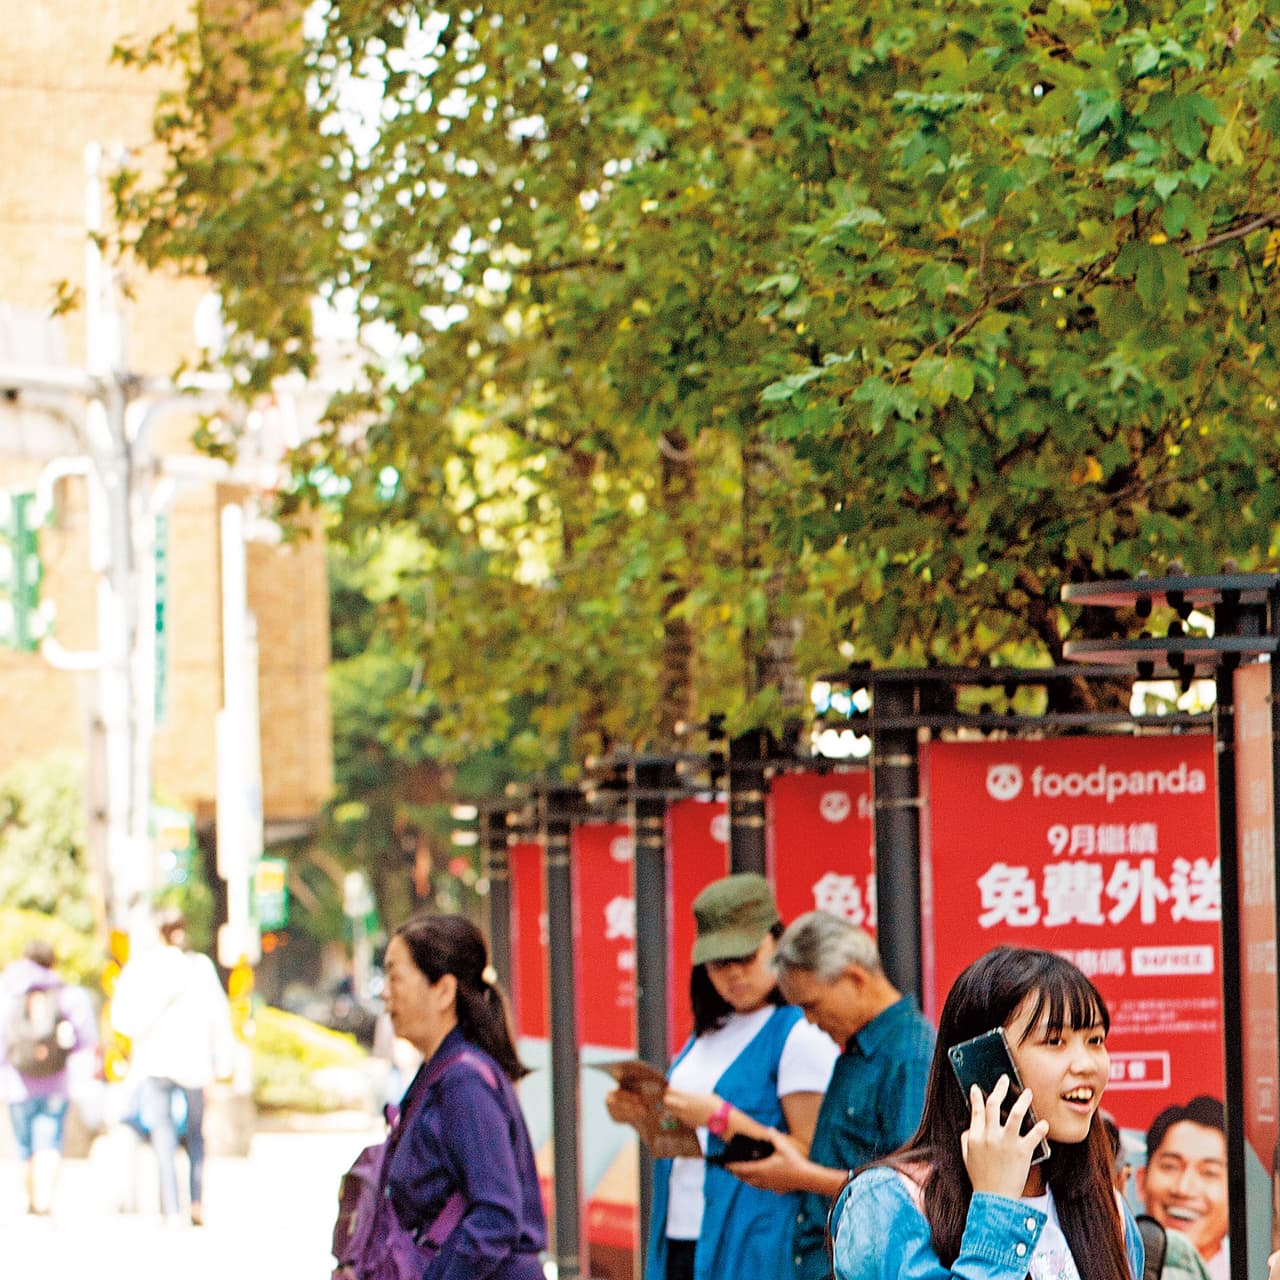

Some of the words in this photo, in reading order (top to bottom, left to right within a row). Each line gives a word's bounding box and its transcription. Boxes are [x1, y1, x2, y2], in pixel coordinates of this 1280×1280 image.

[1032, 763, 1207, 803] foodpanda
[978, 857, 1221, 929] 免費外送
